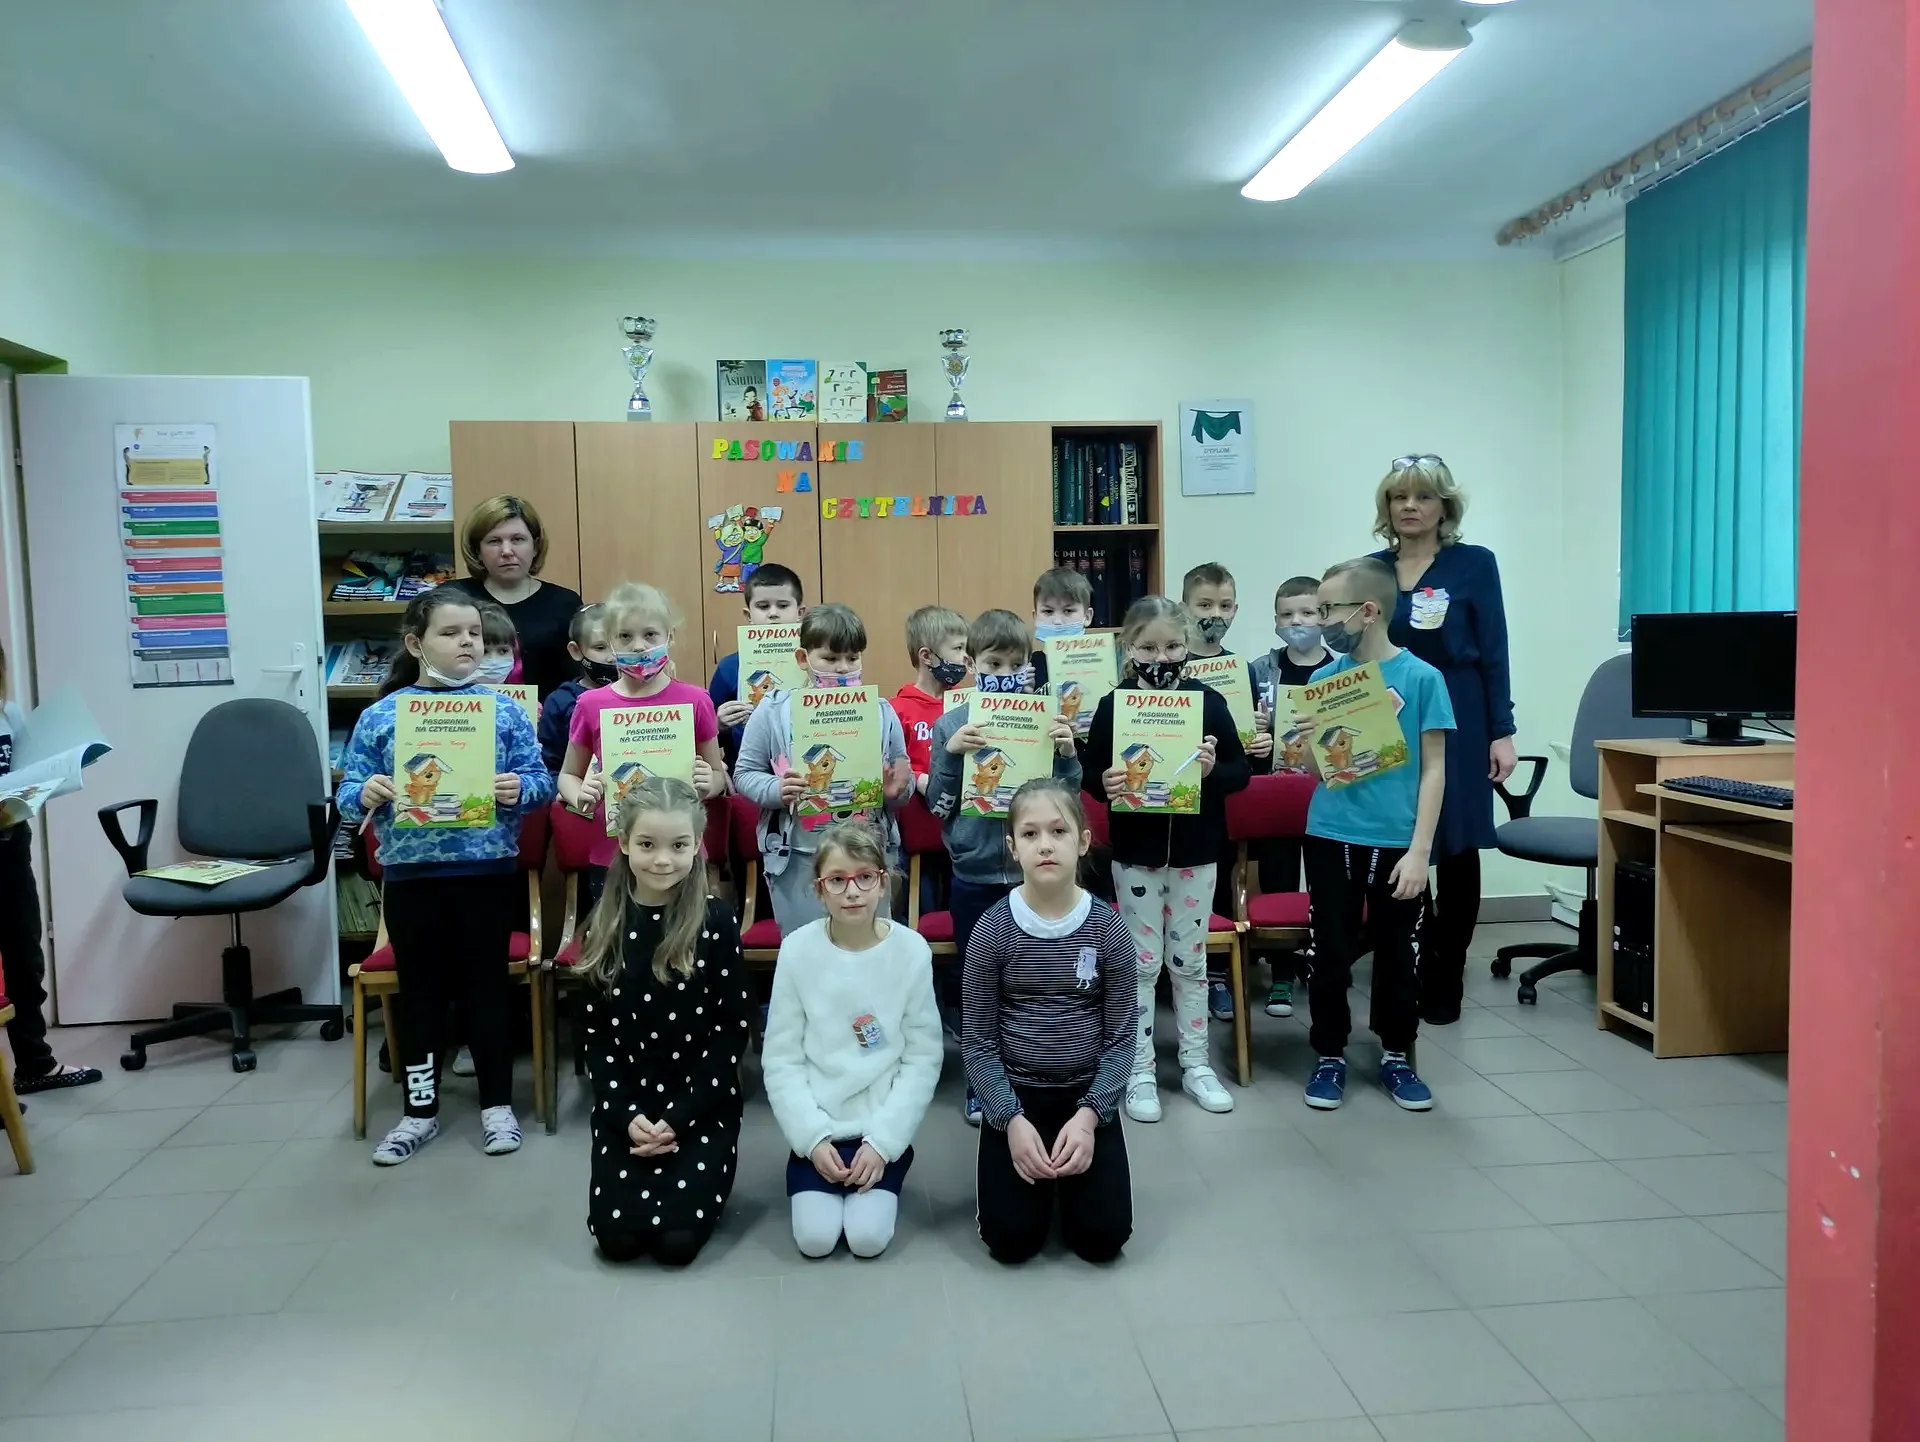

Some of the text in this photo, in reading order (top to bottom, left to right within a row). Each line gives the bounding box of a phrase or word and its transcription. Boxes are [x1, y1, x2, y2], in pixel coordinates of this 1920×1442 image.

[712, 438, 864, 462] PASOWANIE
[776, 471, 812, 493] NA
[1125, 448, 1137, 502] ENCYKLOPEDIA
[823, 494, 987, 519] CZYTELNIKA
[1062, 549, 1076, 558] D-H
[1304, 670, 1371, 701] DYPLOM
[409, 700, 483, 716] DYPLOM
[803, 691, 868, 709] DYPLOM
[981, 697, 1046, 713] DYPLOM
[1126, 695, 1191, 709] DYPLOM
[613, 710, 682, 727] DYPLOM
[816, 709, 857, 718] PASOWANIA
[821, 716, 864, 724] CZYTELNIKA
[991, 714, 1033, 723] PASOWANIA
[626, 727, 670, 735] PASOWANIA
[996, 721, 1039, 730] CZYTELNIKA
[631, 733, 677, 742] CZYTELNIKA
[405, 1052, 436, 1107] GIRL
